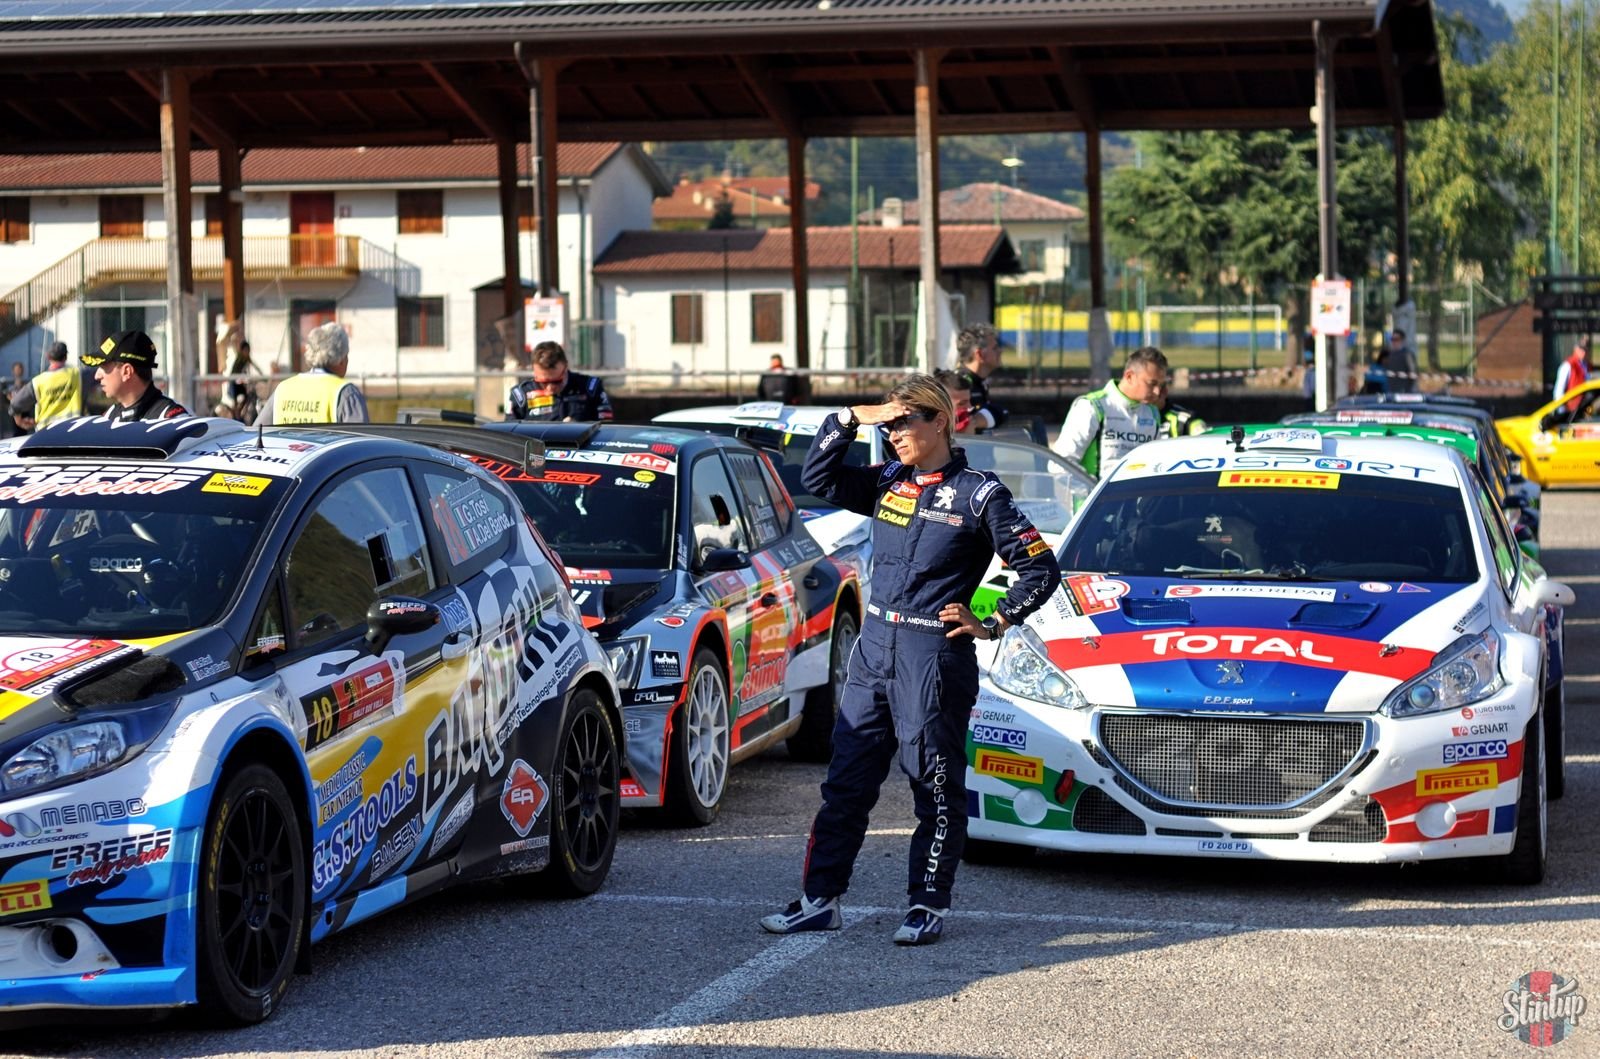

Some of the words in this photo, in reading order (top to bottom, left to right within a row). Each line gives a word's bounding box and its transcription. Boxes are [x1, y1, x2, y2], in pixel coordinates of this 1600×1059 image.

[191, 450, 290, 465] BARDAHL
[624, 454, 668, 468] MAP
[1235, 455, 1437, 479] SPORT
[209, 481, 260, 491] BARDAHL
[921, 475, 942, 484] TOTAL
[1230, 474, 1330, 486] PIRELLI
[900, 483, 919, 495] TOTAL
[462, 495, 489, 523] G.Tosi
[907, 616, 945, 628] ANDREUSSI
[1142, 631, 1334, 663] TOTAL
[20, 651, 54, 662] 18
[517, 675, 558, 720] Technological
[312, 696, 333, 743] 18
[982, 711, 1016, 724] GENART
[974, 726, 1026, 746] sparco
[1470, 723, 1509, 735] GENART
[1444, 741, 1507, 761] sparco
[981, 755, 1037, 778] PIRELLI
[934, 755, 948, 803] SPORT
[1424, 769, 1489, 790] PIRELLI
[924, 804, 949, 892] PEUGEOT
[1202, 841, 1214, 849] FD
[1235, 842, 1248, 850] PD
